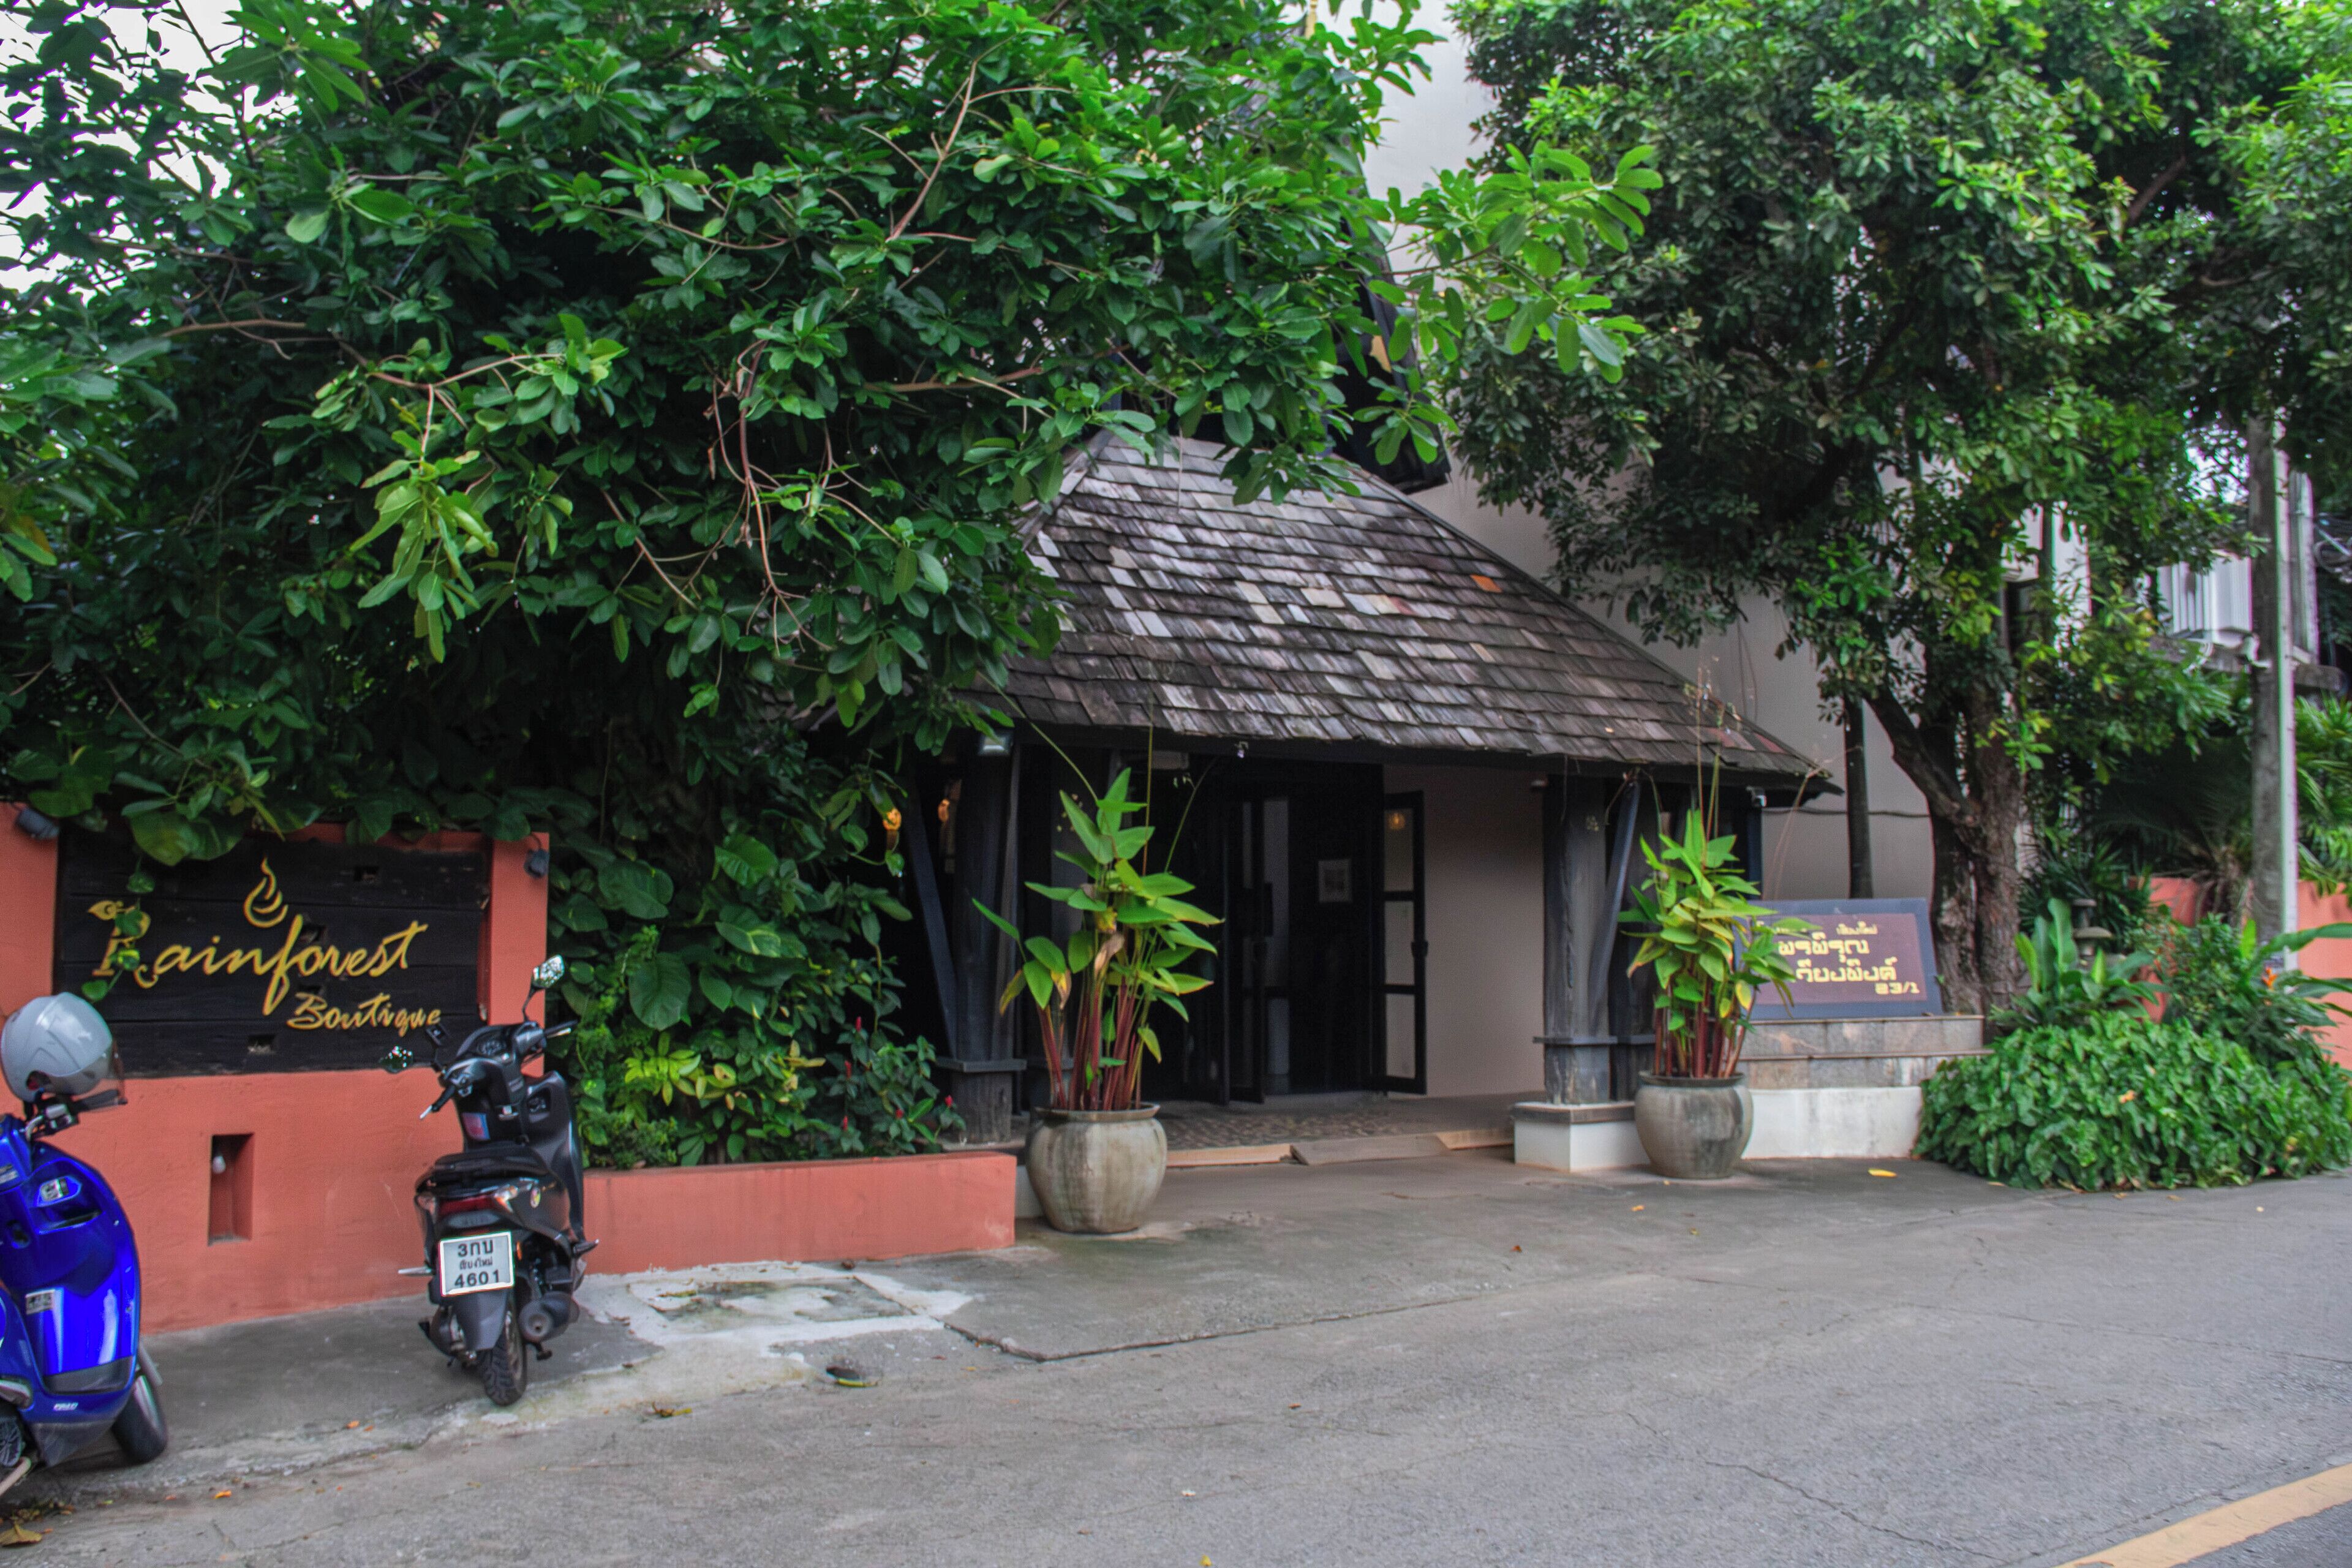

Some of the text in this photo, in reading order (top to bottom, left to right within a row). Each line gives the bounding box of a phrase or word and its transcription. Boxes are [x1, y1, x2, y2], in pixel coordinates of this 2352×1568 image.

[87, 900, 429, 1017] Rainforest
[1795, 956, 1898, 983] วียงพิงค์
[287, 992, 441, 1037] Boutique
[454, 1268, 500, 1289] 4601
